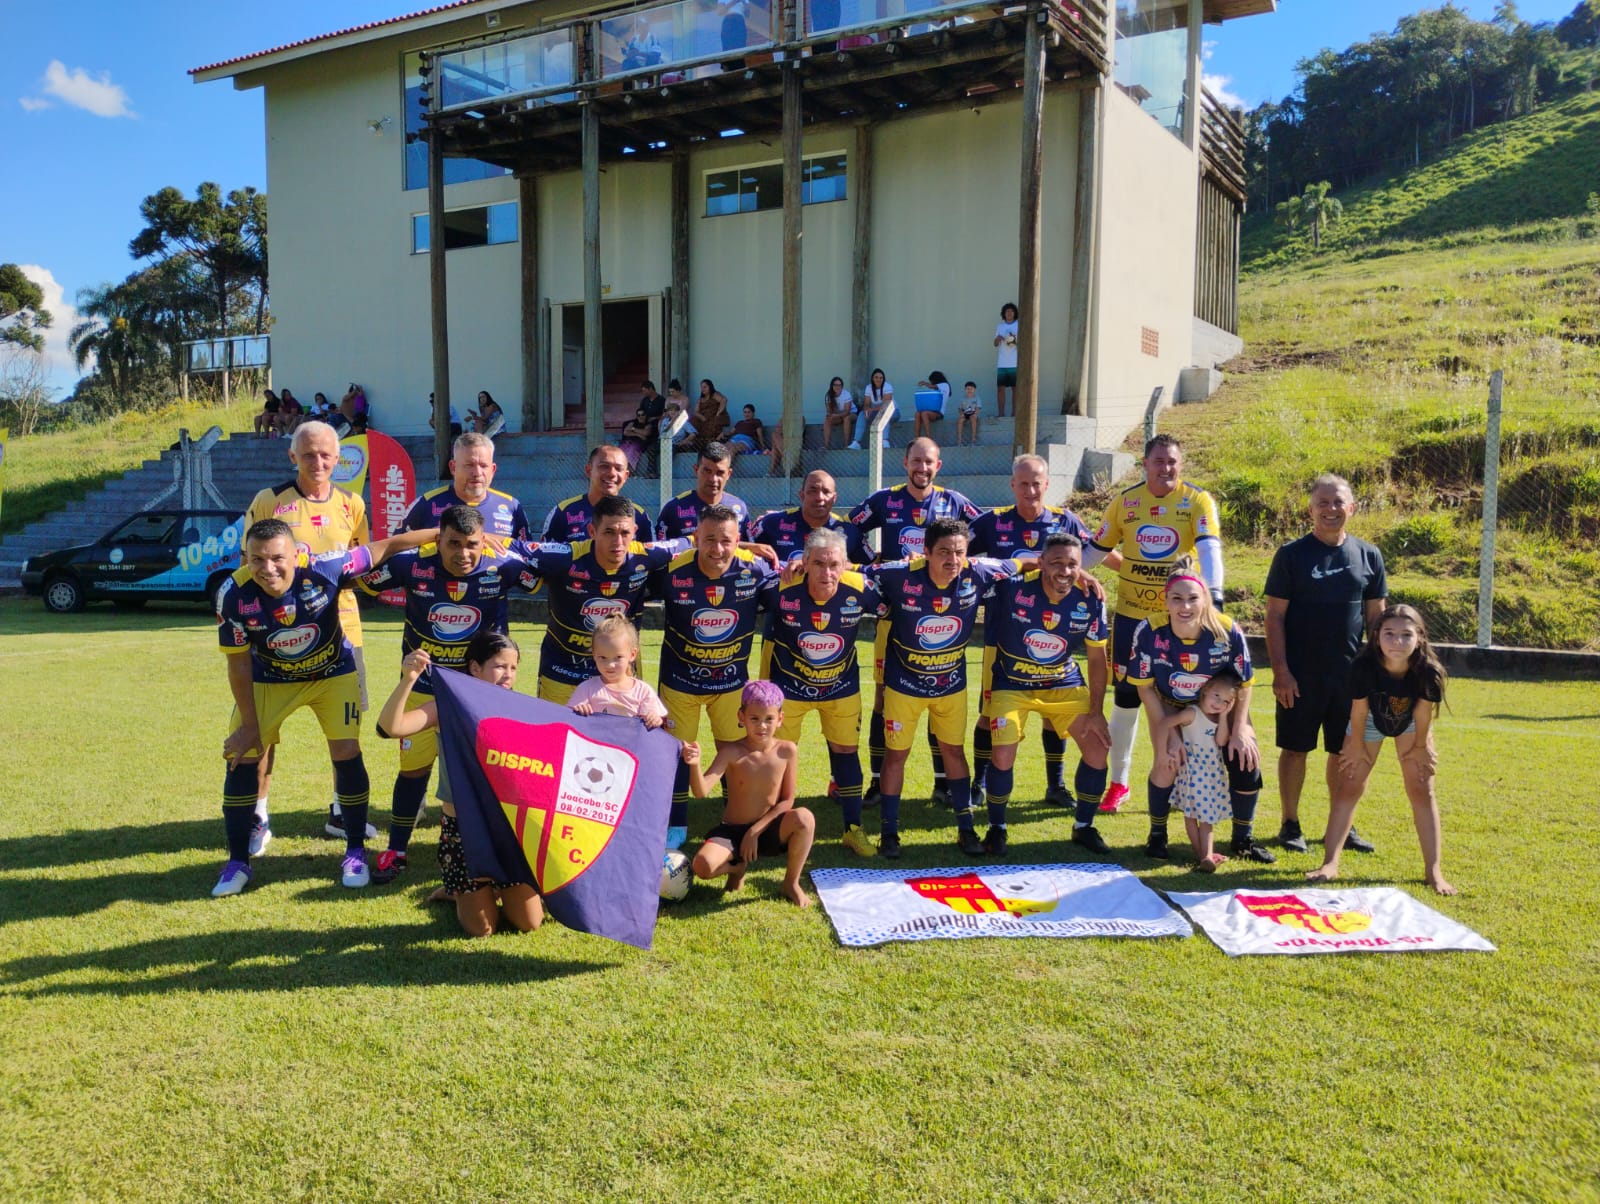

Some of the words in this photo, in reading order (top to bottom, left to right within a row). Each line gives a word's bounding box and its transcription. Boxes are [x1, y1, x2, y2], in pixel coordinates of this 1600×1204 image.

[899, 536, 925, 545] Dispr
[1136, 533, 1171, 544] Dispra
[177, 525, 238, 571] 104,9
[429, 612, 472, 625] Dispra
[691, 617, 731, 628] Dispra
[917, 624, 954, 635] Dispra
[268, 631, 312, 650] Dispra
[798, 639, 836, 652] Dispra
[1023, 637, 1060, 650] Dispra
[421, 640, 469, 659] PIONEI
[684, 642, 742, 659] PIONEIRO
[907, 648, 965, 667] PIONEIRO
[344, 702, 360, 726] 14
[485, 749, 555, 778] DISPRA
[560, 802, 616, 823] 08/02/2012
[561, 825, 574, 841] F.
[568, 848, 586, 865] C.
